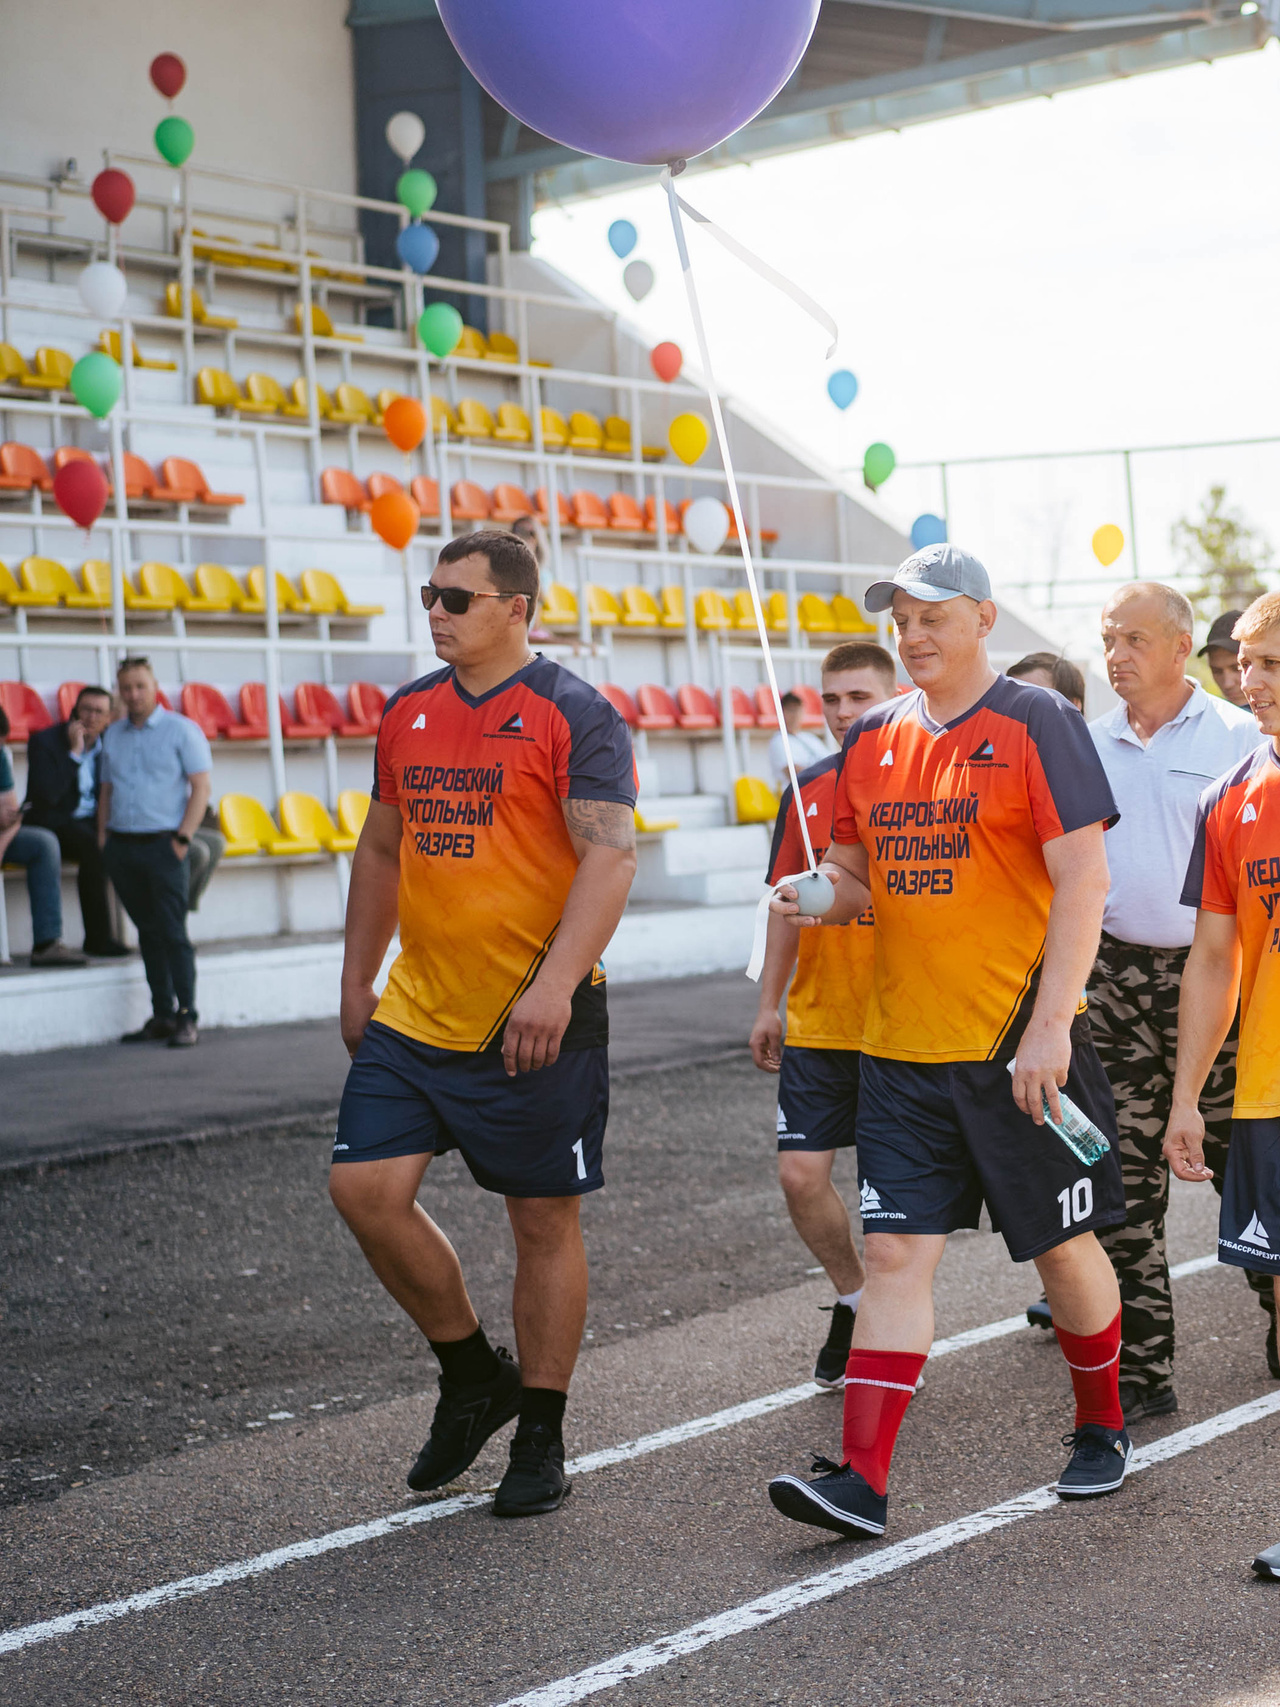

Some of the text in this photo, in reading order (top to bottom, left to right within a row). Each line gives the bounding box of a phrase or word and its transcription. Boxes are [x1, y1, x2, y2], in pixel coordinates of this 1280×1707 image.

[402, 762, 504, 794] КЕДРОВСКИЙ
[408, 794, 494, 826] УГОЛЬНЫЙ
[868, 791, 980, 832] КЕДРОВСКИЙ
[415, 832, 475, 859] РАЗРЕЗ
[875, 825, 971, 862] УГОЛЬНЫЙ
[887, 869, 954, 895] РАЗРЕЗ
[571, 1137, 588, 1181] 1
[1057, 1177, 1094, 1229] 10
